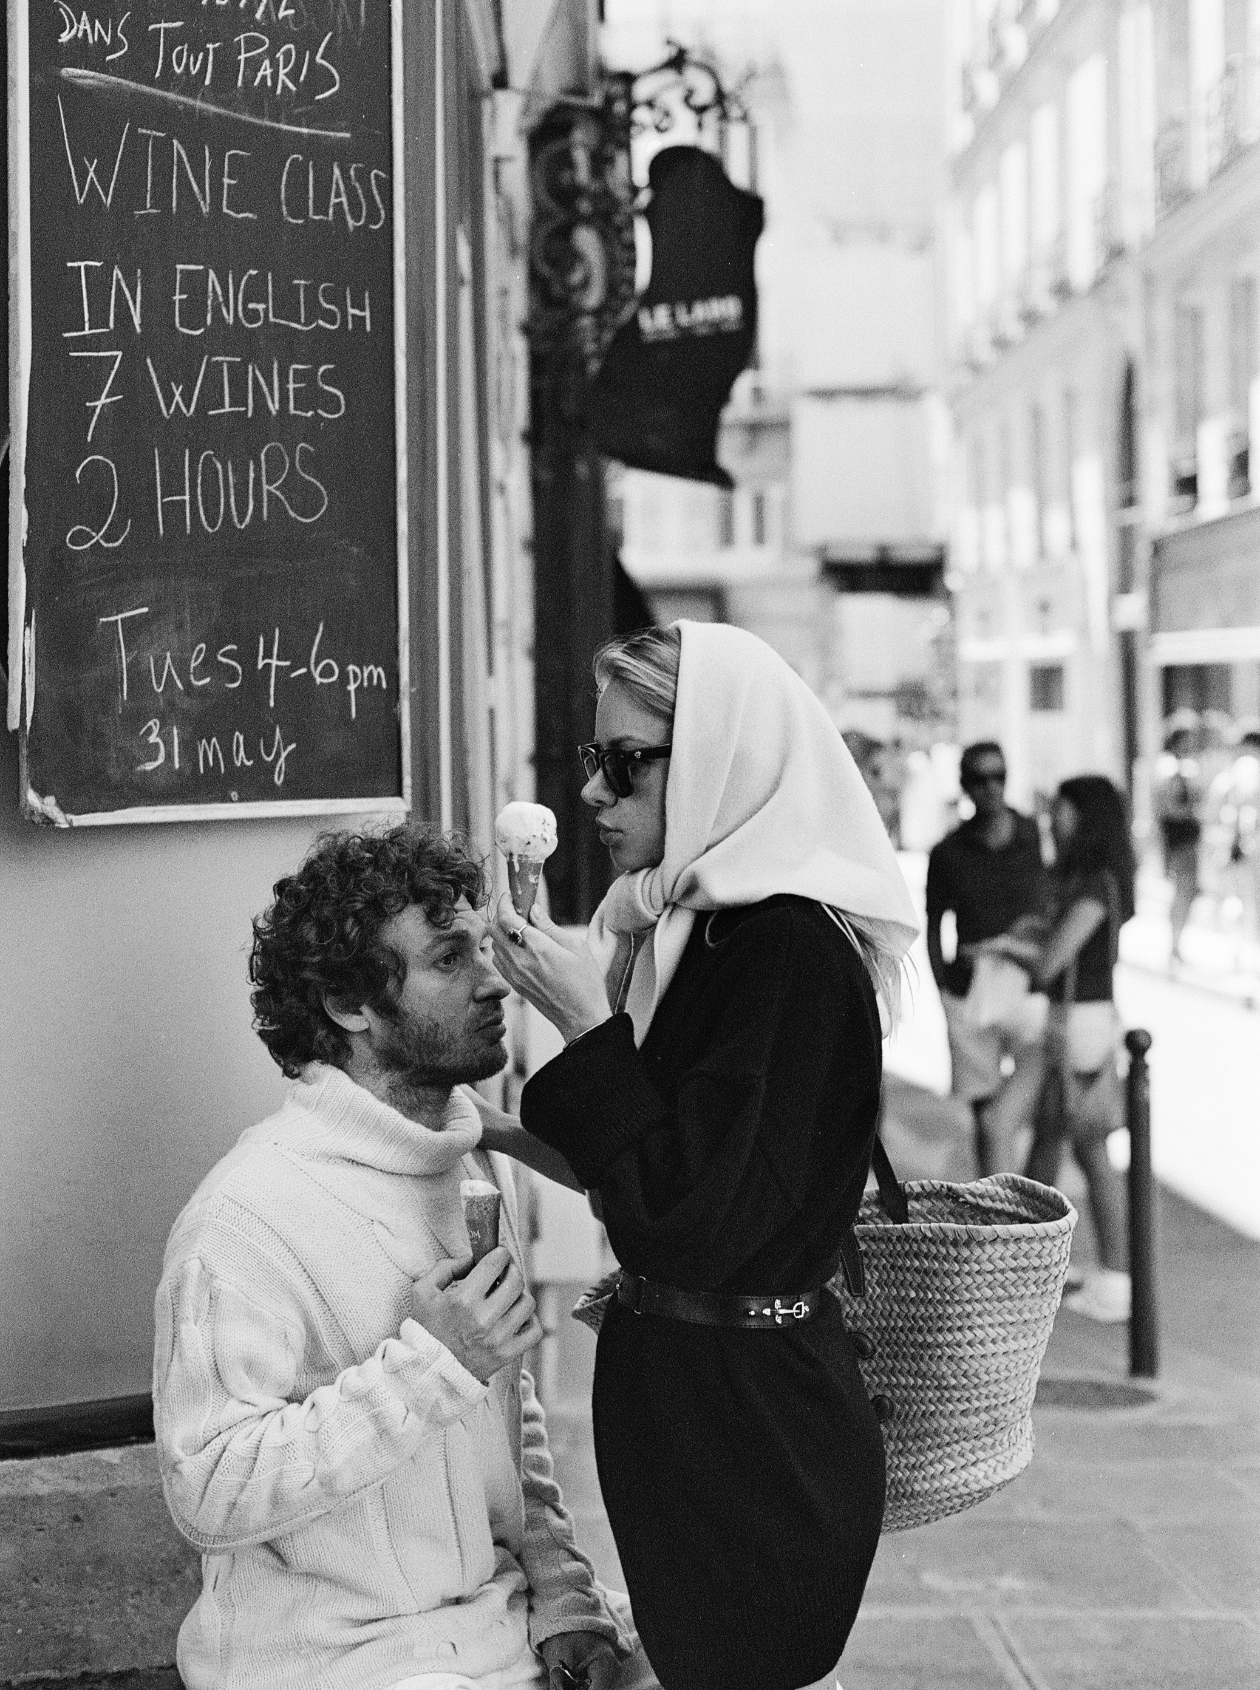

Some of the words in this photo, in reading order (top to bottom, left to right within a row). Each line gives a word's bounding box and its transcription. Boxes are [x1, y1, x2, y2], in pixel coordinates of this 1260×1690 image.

[54, 0, 131, 62] DANS
[234, 32, 340, 100] PARIS
[57, 94, 258, 218] WINE
[281, 154, 386, 231] CLASS
[63, 261, 141, 337] IN
[173, 264, 370, 335] ENGLISH
[69, 350, 123, 442] 7
[147, 356, 345, 418] WINES
[66, 455, 131, 550] 2
[155, 443, 328, 535] HOURS
[99, 607, 242, 700] Tues
[137, 718, 180, 771] 31
